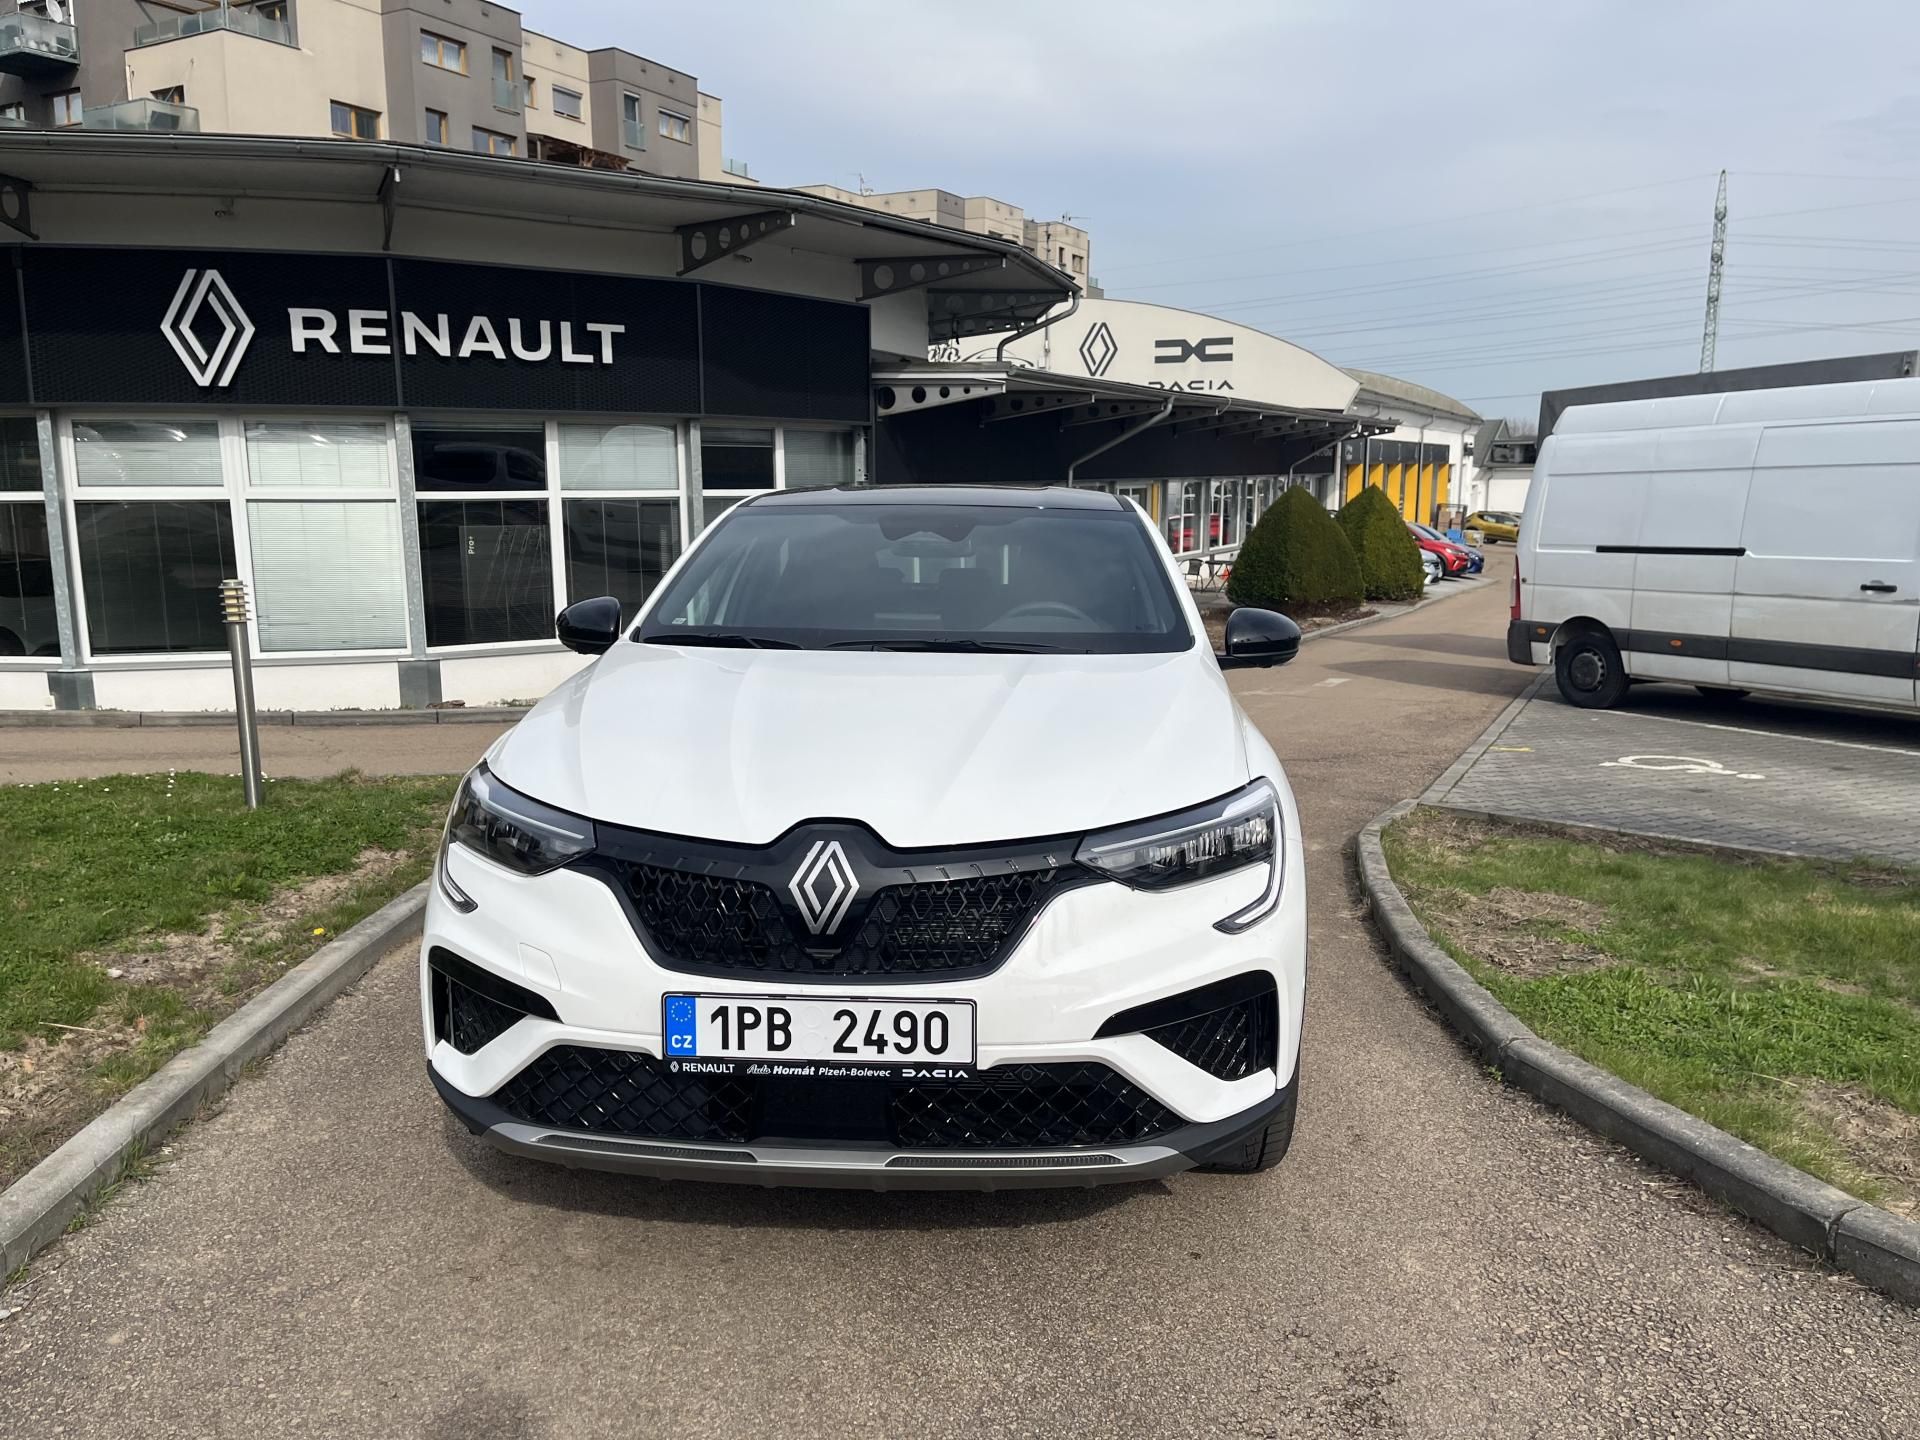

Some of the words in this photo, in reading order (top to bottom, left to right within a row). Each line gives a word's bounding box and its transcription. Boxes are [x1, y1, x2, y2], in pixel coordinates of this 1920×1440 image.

[287, 307, 626, 364] RENAULT
[1147, 379, 1235, 391] DACIA
[710, 1005, 792, 1052] 1PB
[832, 1009, 949, 1055] 2490
[671, 1034, 693, 1048] CZ
[682, 1062, 735, 1073] RENAULT
[772, 1065, 816, 1076] Hornát
[818, 1066, 892, 1077] Plzeň-Bolevec
[902, 1068, 969, 1079] DACIA
